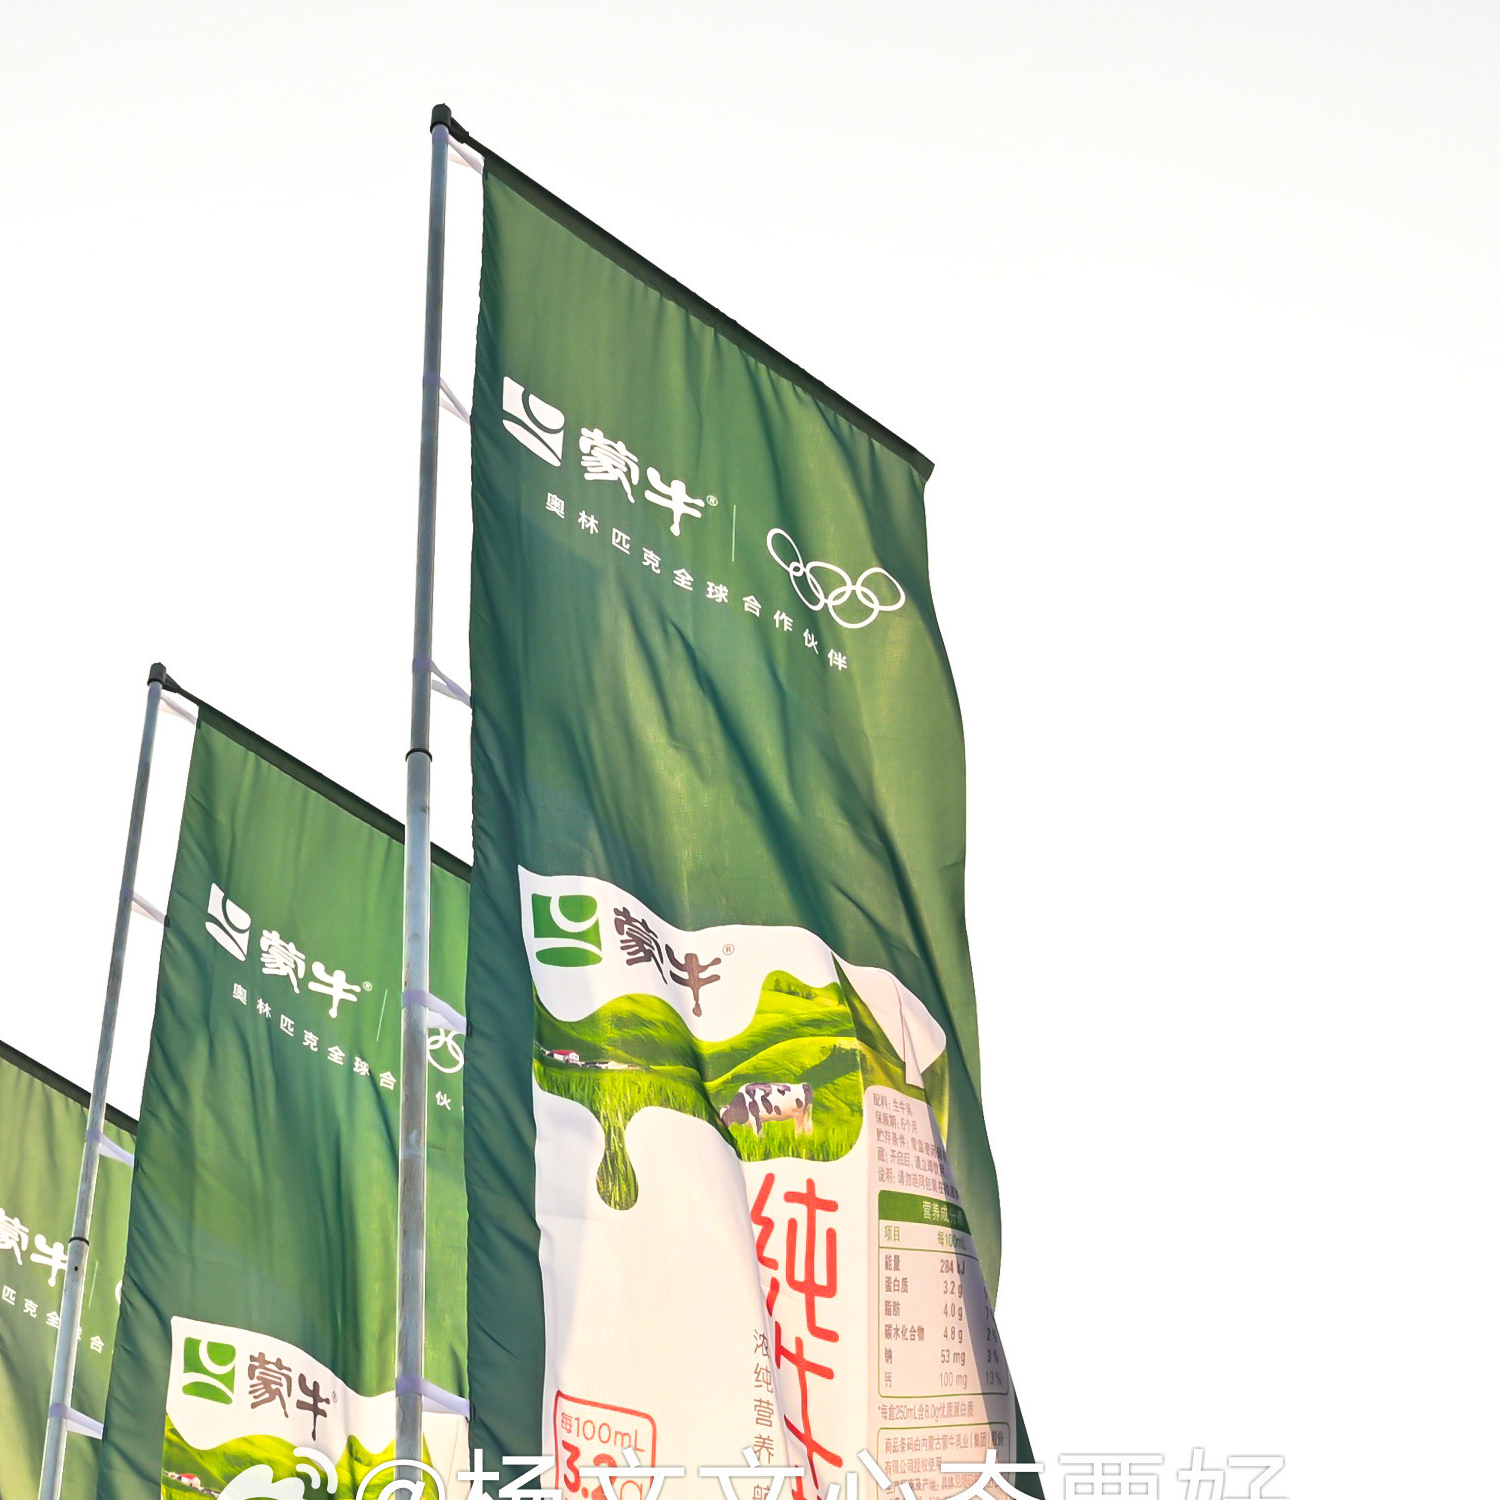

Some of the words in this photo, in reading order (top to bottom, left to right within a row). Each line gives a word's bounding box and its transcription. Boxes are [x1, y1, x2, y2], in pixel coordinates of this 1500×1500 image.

[579, 427, 705, 537] 蒙牛
[546, 492, 848, 671] 奥林匹克全球合作伙伴
[260, 929, 362, 1018] 蒙牛
[613, 906, 723, 1018] 蒙牛
[232, 983, 466, 1112] 奥林匹克全球合伙
[884, 1225, 900, 1243] 项目
[884, 1254, 900, 1271] 能量
[884, 1277, 909, 1294] 蛋白质
[884, 1300, 900, 1317] 脂肪
[884, 1324, 925, 1341] 碳水化合物
[247, 1352, 331, 1441] 蒙牛
[561, 1411, 646, 1454] 每100mL
